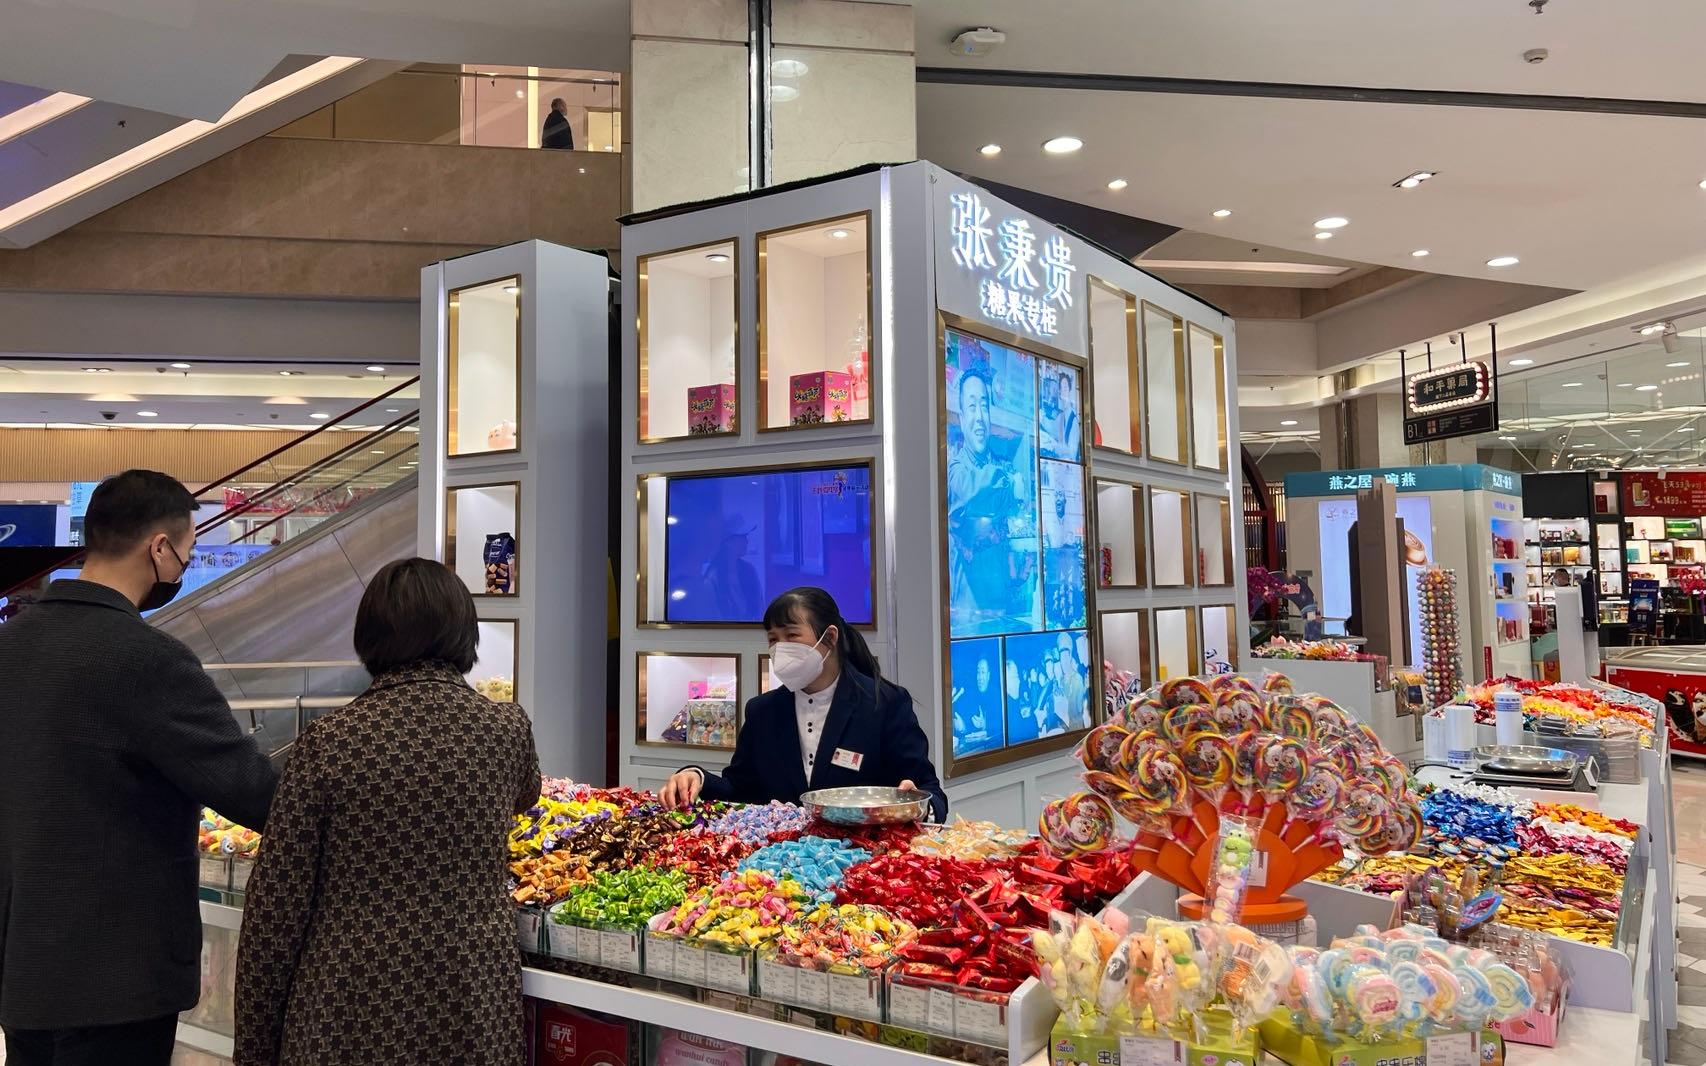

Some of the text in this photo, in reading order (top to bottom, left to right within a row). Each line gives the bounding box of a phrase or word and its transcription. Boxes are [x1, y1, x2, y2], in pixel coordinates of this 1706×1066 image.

[950, 192, 1077, 310] 张秉贵
[980, 279, 1058, 336] 糖果专柜
[1329, 474, 1373, 490] 燕之屋
[551, 1024, 572, 1045] 春光
